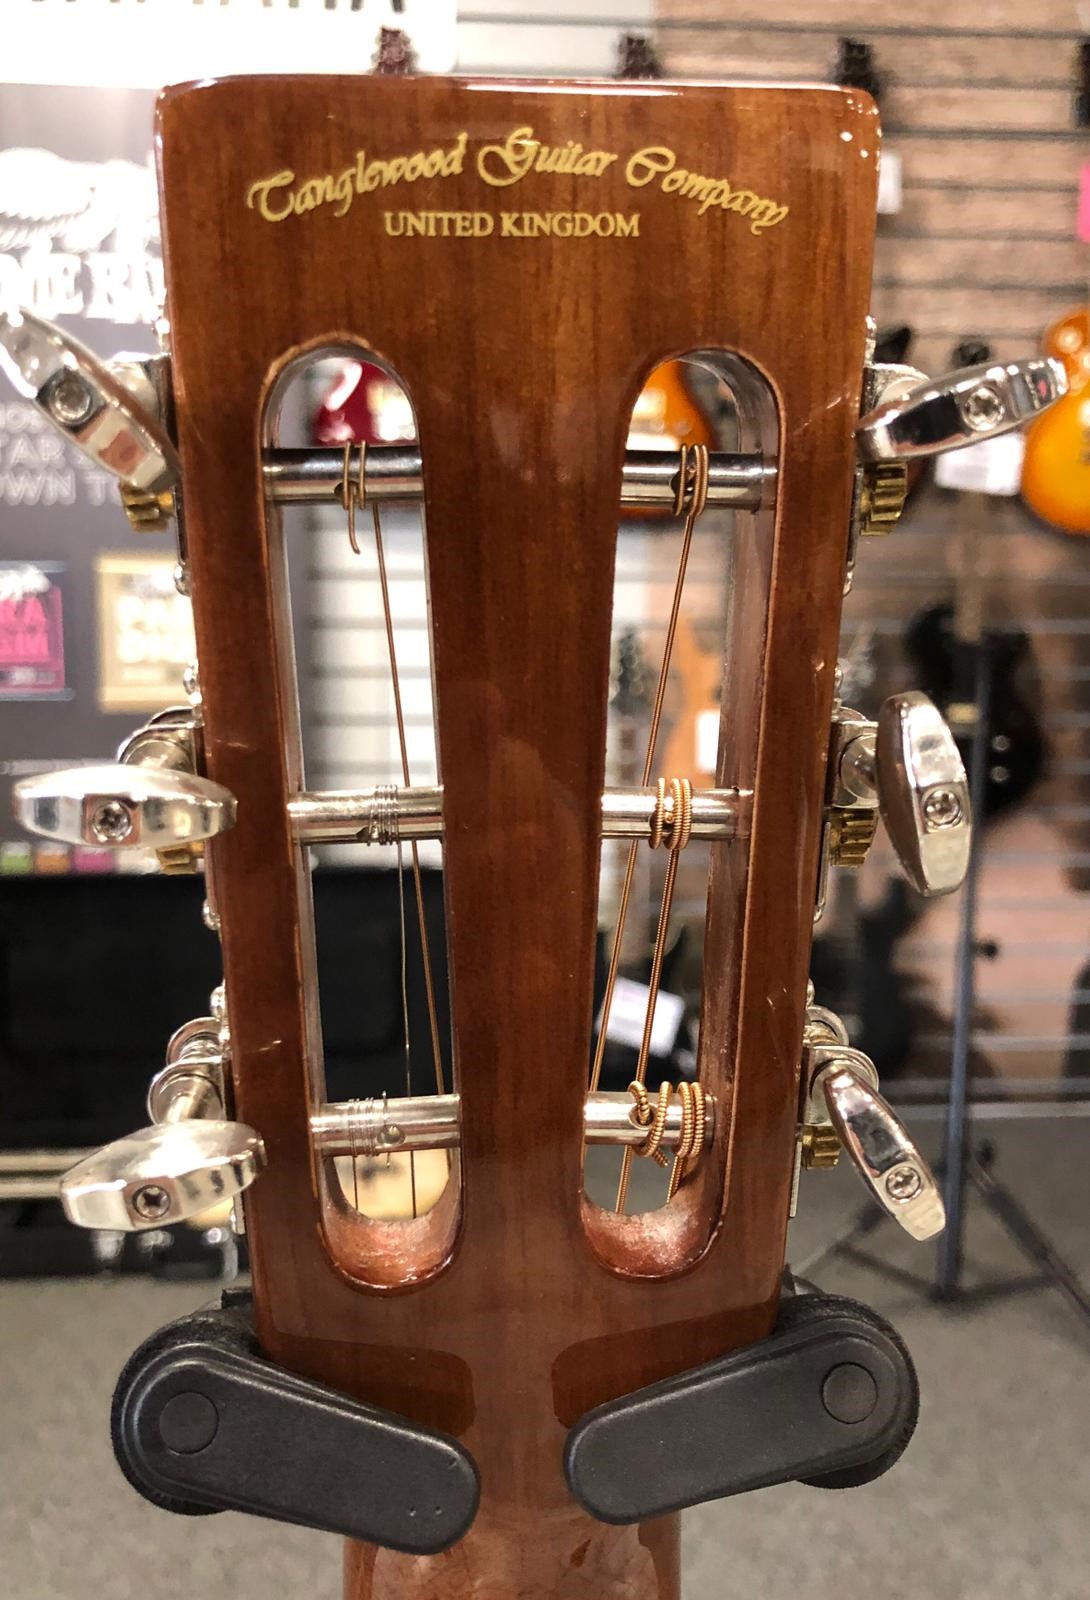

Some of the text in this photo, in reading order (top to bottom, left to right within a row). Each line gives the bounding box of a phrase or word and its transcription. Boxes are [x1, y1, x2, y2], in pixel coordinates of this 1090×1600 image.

[247, 126, 790, 235] Tanglewood Guitar Company
[384, 211, 641, 237] UNITED KINGDOM
